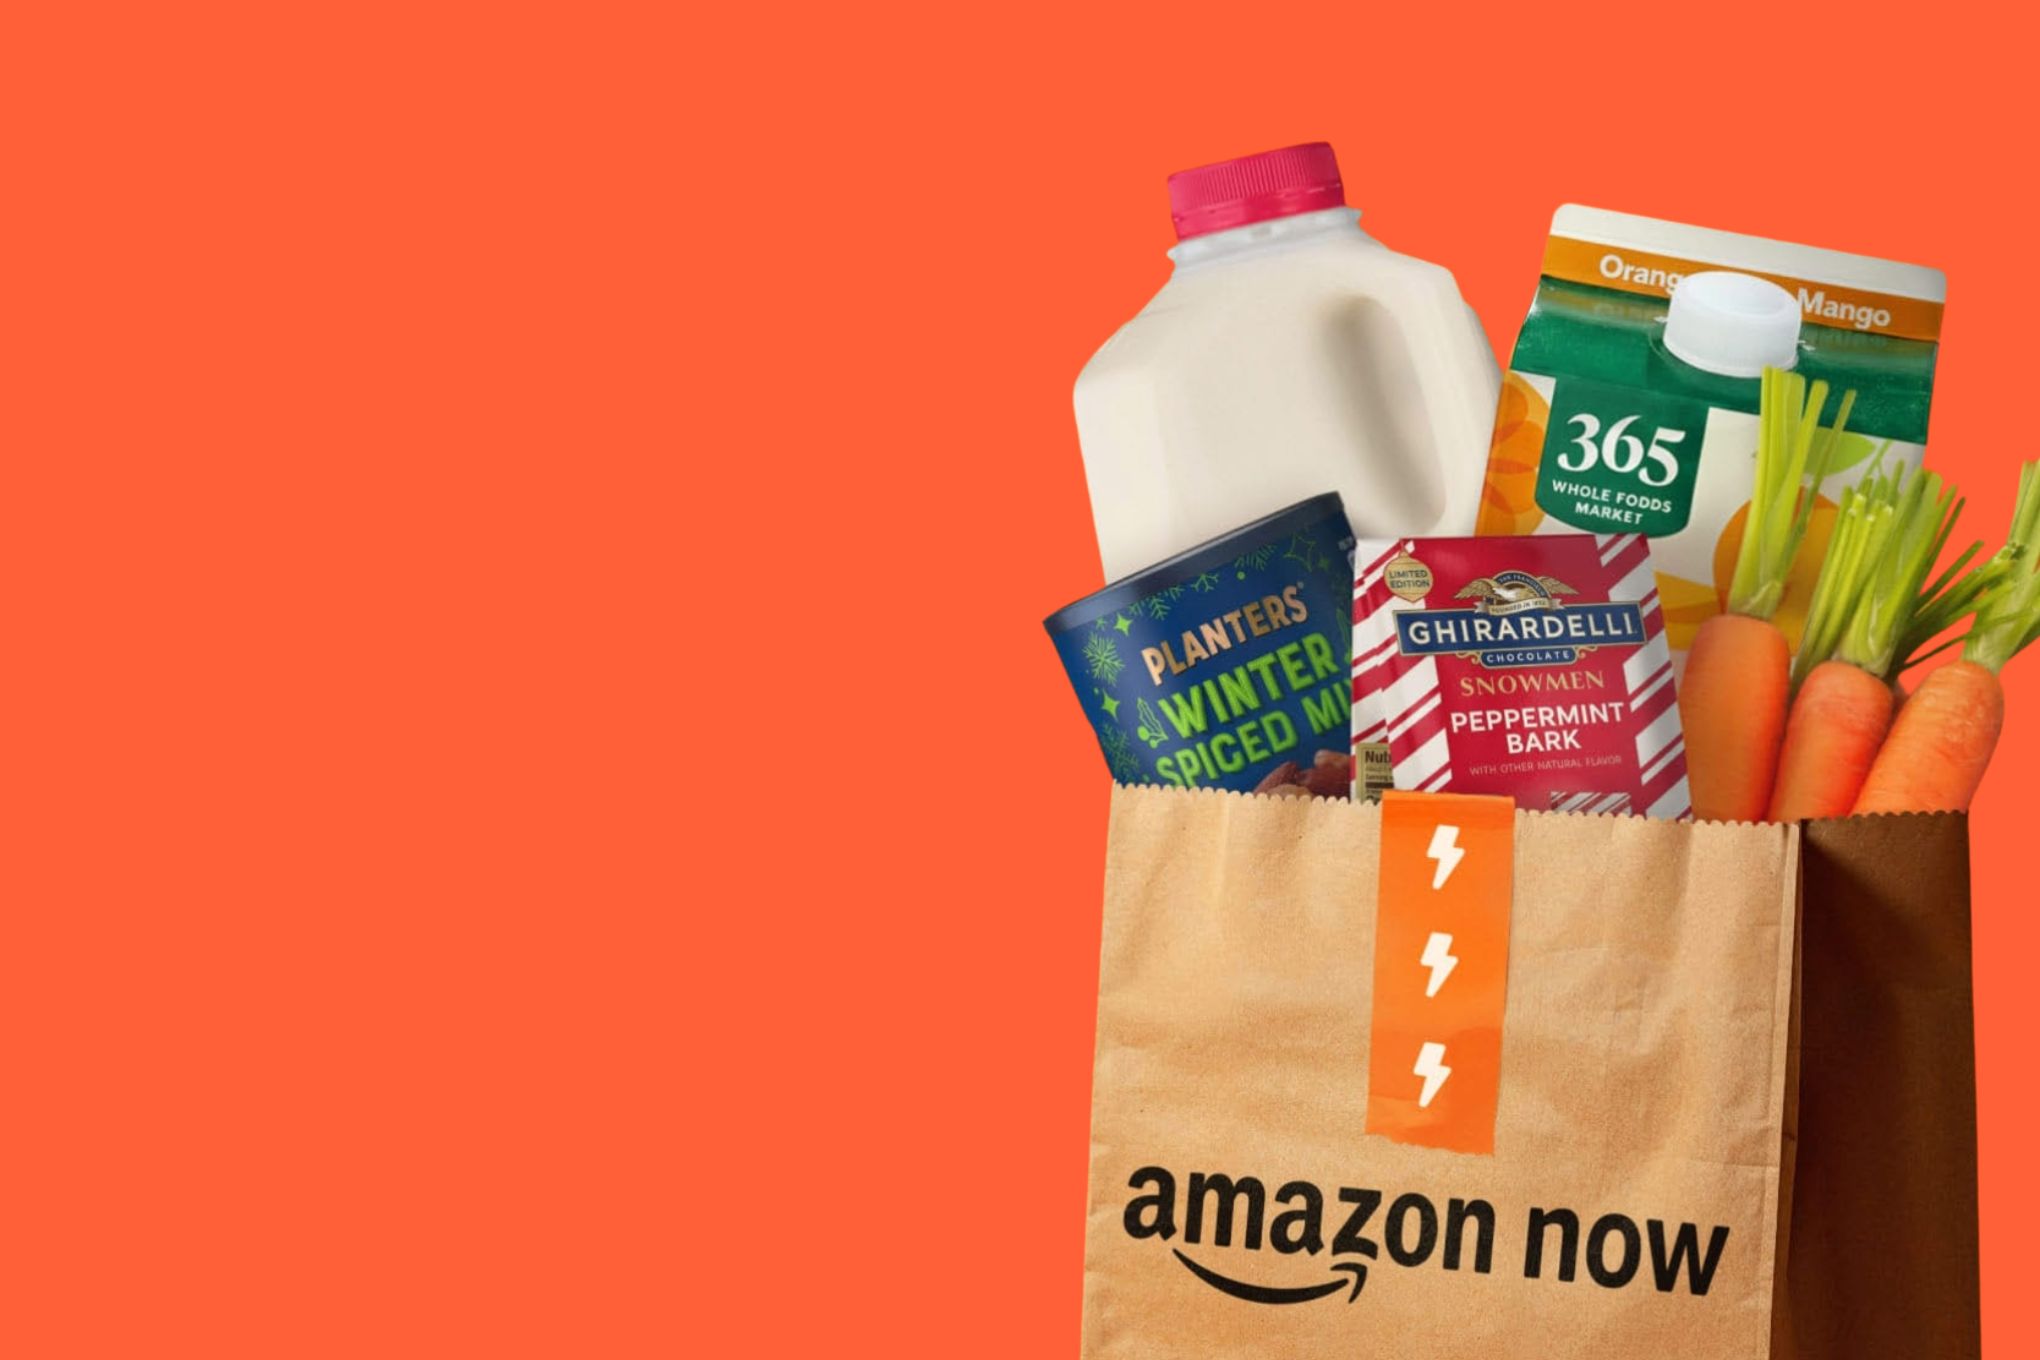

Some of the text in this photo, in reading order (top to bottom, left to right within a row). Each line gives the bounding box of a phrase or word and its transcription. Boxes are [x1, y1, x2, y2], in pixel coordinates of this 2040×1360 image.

[1600, 254, 1686, 296] Orang
[1797, 287, 1890, 330] Mango
[1557, 413, 1685, 487] 365
[1552, 479, 1611, 502] WHOLE
[1575, 501, 1642, 525] MARKET
[1389, 570, 1428, 579] LIMITED
[1390, 579, 1430, 589] EDITION
[1141, 586, 1307, 686] PLANTERS
[1408, 614, 1635, 645] GHIRARDELLI
[1486, 649, 1571, 664] CHOCOLATE
[1158, 632, 1340, 739] WINTER
[1459, 670, 1605, 696] SNOWMEN
[1450, 702, 1624, 733] PEPPERMINT
[1155, 710, 1298, 787] SPICED
[1506, 729, 1582, 755] BARK
[1469, 754, 1622, 776] WITH OTHER NATURAL FLAVOR
[1122, 1166, 1730, 1296] amazon now
